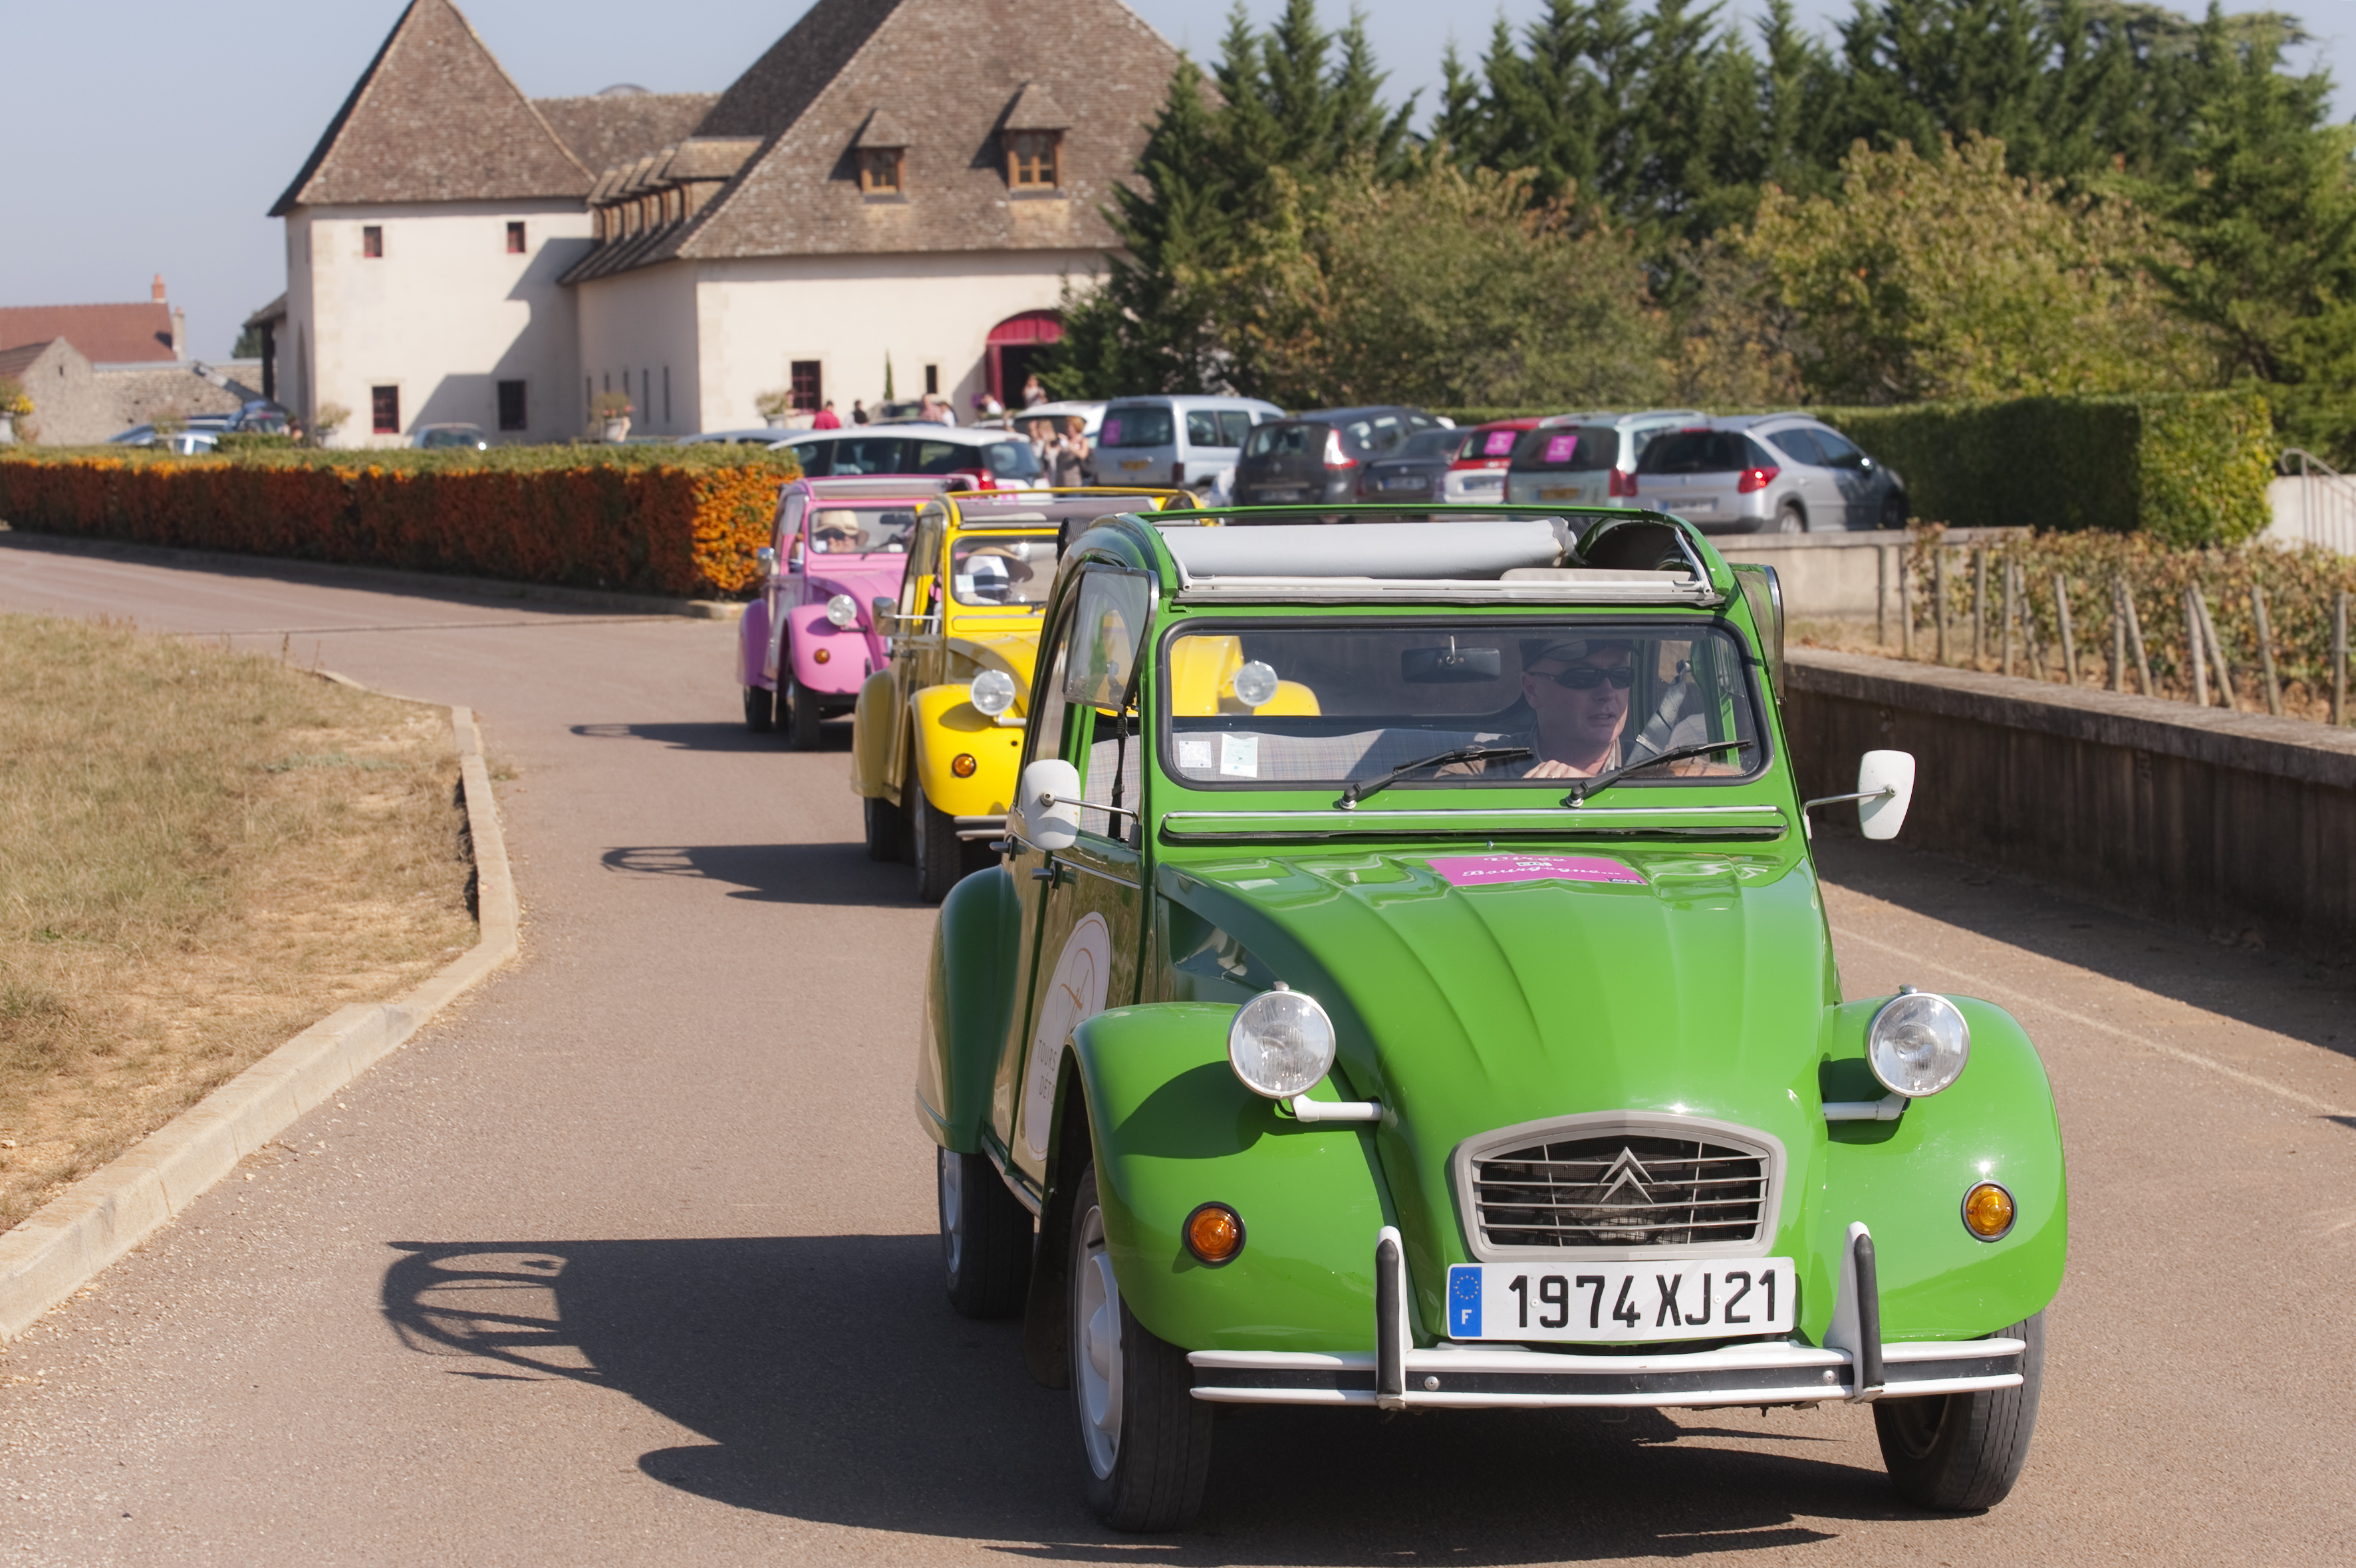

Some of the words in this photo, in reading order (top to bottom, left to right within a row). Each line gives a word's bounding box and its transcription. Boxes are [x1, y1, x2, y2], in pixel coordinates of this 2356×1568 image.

[1037, 1039, 1057, 1072] TOURS
[1508, 1275, 1641, 1329] 1974
[1655, 1271, 1712, 1327] XJ
[1724, 1269, 1776, 1325] 21
[1461, 1309, 1472, 1325] F
